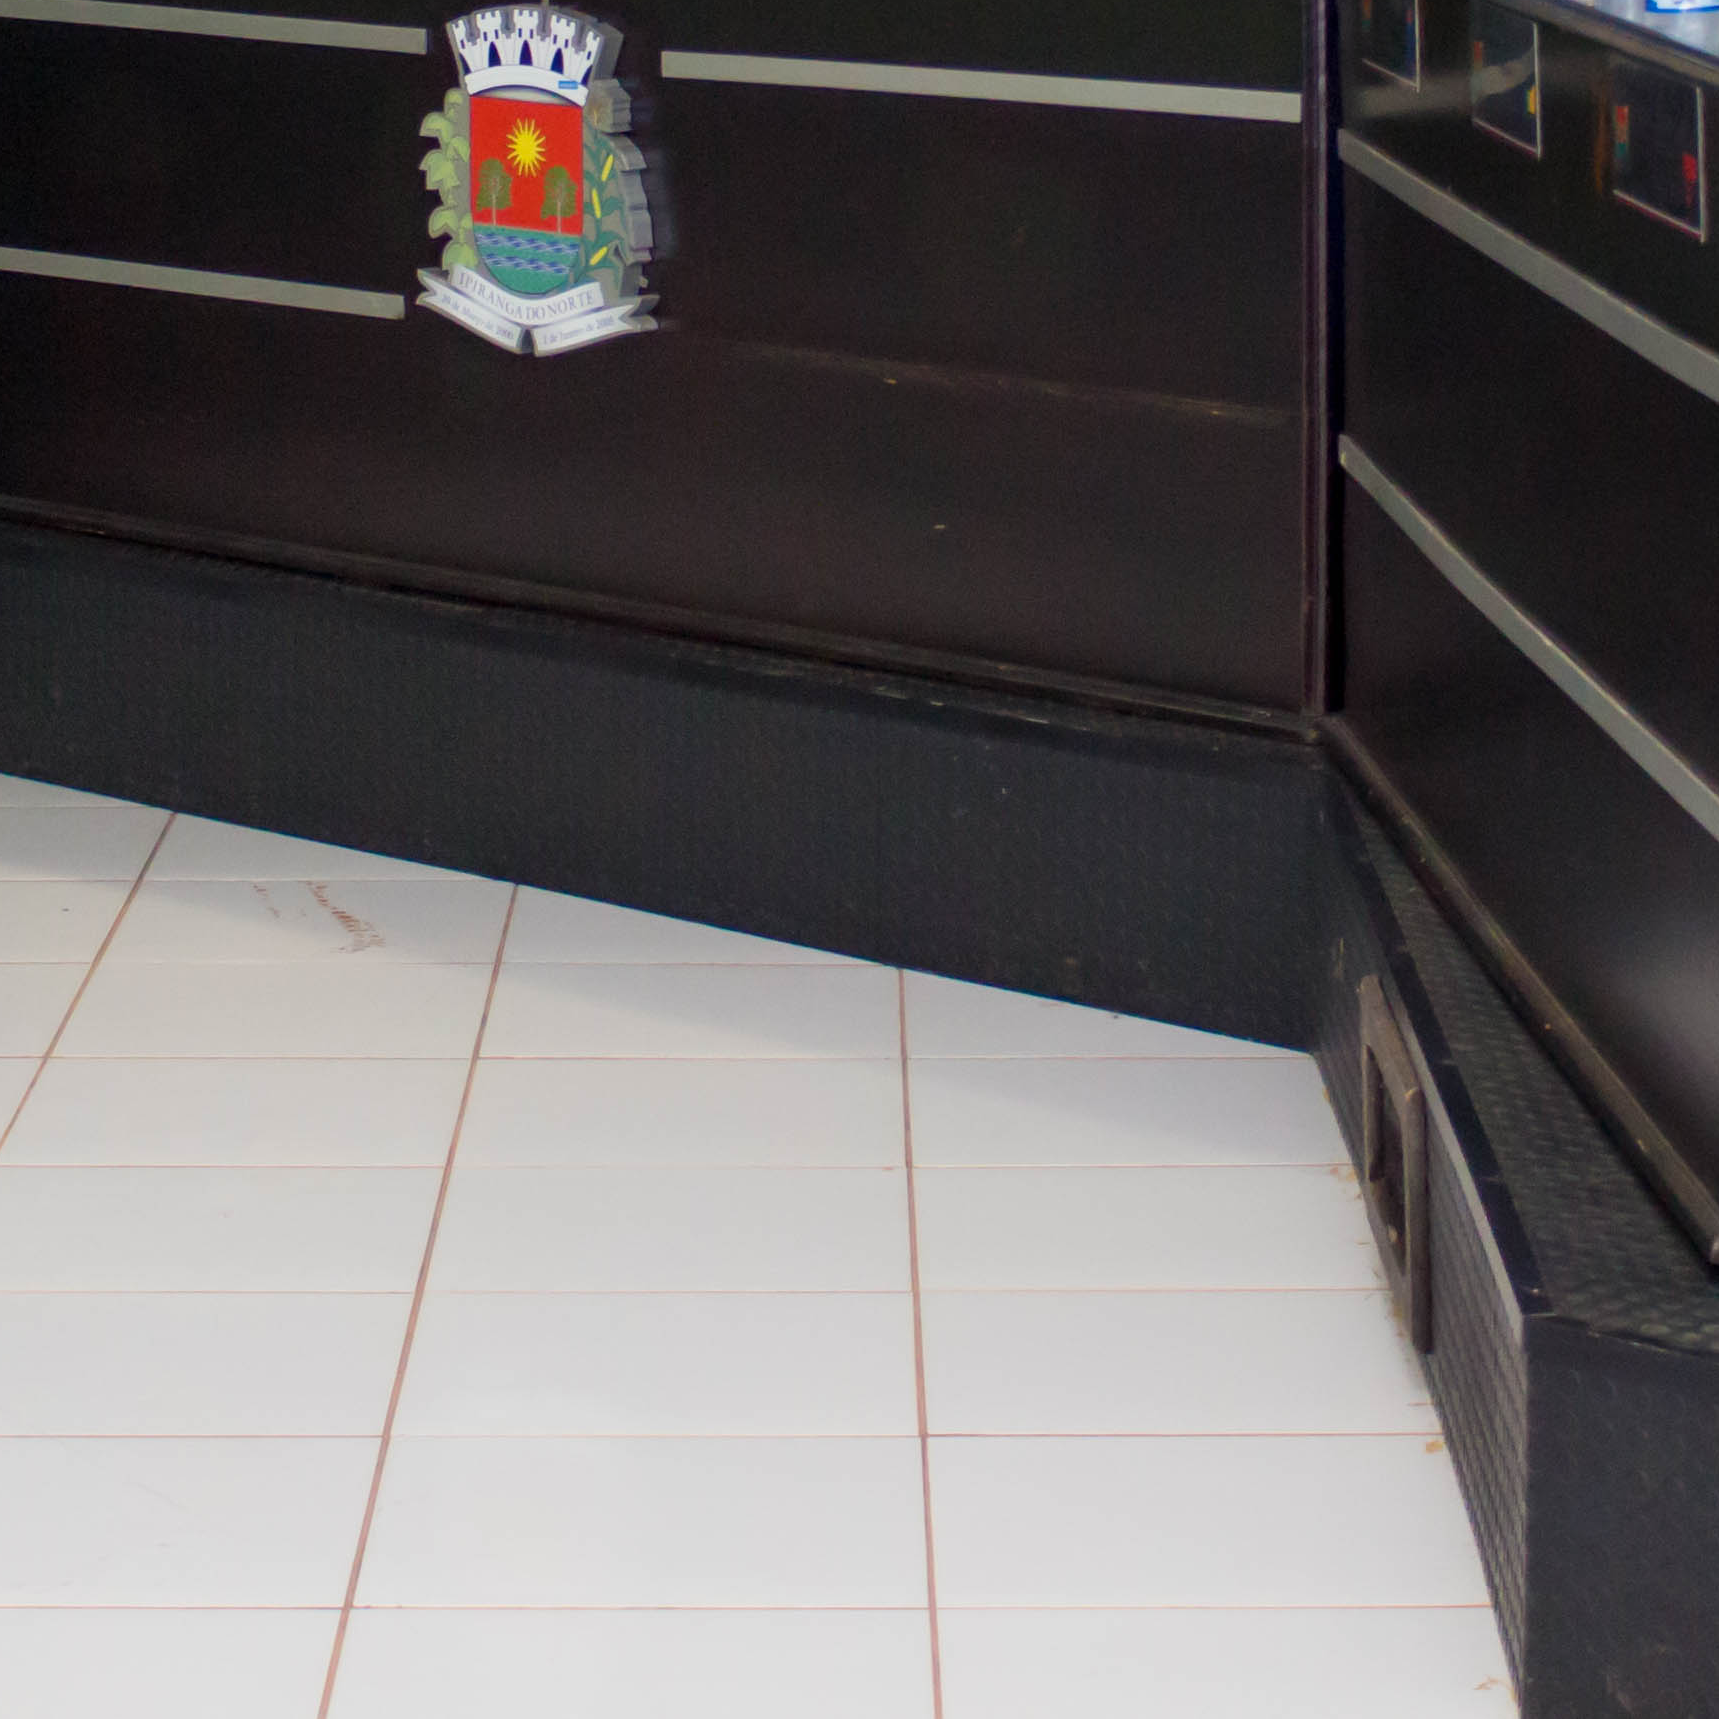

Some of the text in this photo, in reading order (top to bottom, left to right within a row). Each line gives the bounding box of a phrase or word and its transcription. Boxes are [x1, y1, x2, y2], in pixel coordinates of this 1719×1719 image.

[458, 272, 524, 320] IPIRANGA
[525, 305, 546, 321] DO
[546, 289, 595, 315] NORTE
